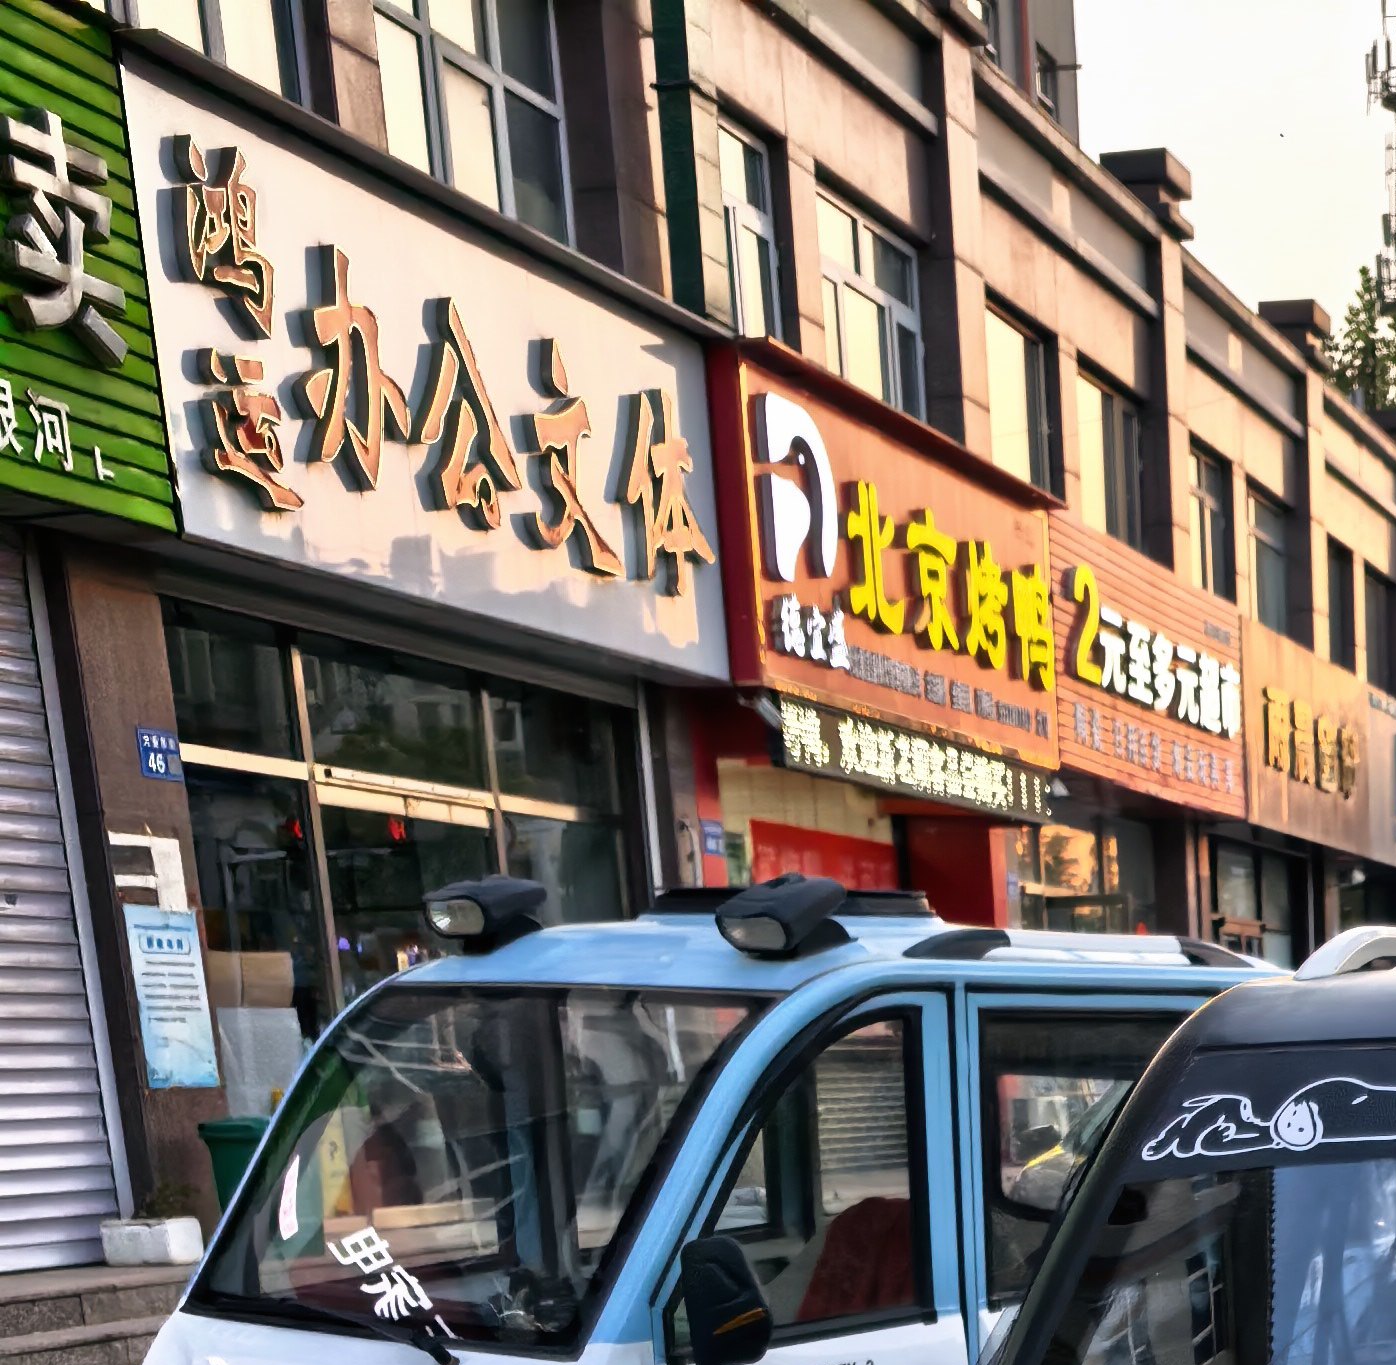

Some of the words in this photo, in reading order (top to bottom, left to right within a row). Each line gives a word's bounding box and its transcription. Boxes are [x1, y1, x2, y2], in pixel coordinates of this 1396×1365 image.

[306, 243, 717, 598] 办公文体
[847, 479, 1056, 693] 北京烤鸭
[1073, 564, 1242, 741] 2元至多元超市
